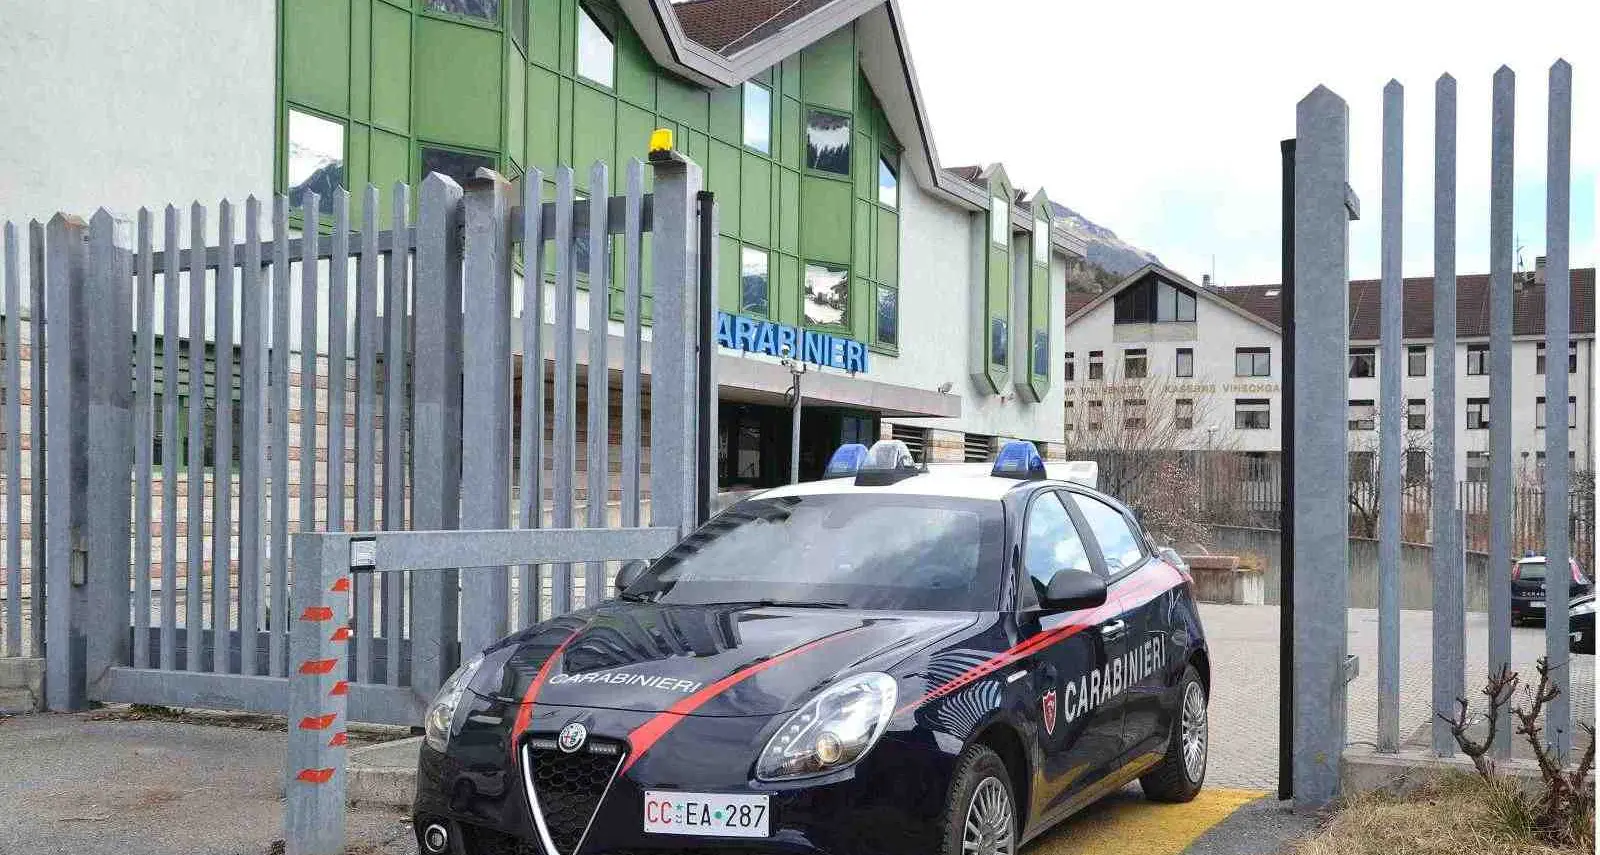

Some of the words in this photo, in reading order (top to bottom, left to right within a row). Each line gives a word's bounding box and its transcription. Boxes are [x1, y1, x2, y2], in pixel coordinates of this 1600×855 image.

[716, 311, 870, 374] ARABINIERI
[1222, 382, 1281, 393] VINSCHGA
[549, 672, 703, 693] CARABINIERI
[1064, 633, 1166, 723] CARABINIERI
[647, 800, 672, 824] CC
[686, 802, 711, 826] EA
[725, 804, 766, 828] 287
